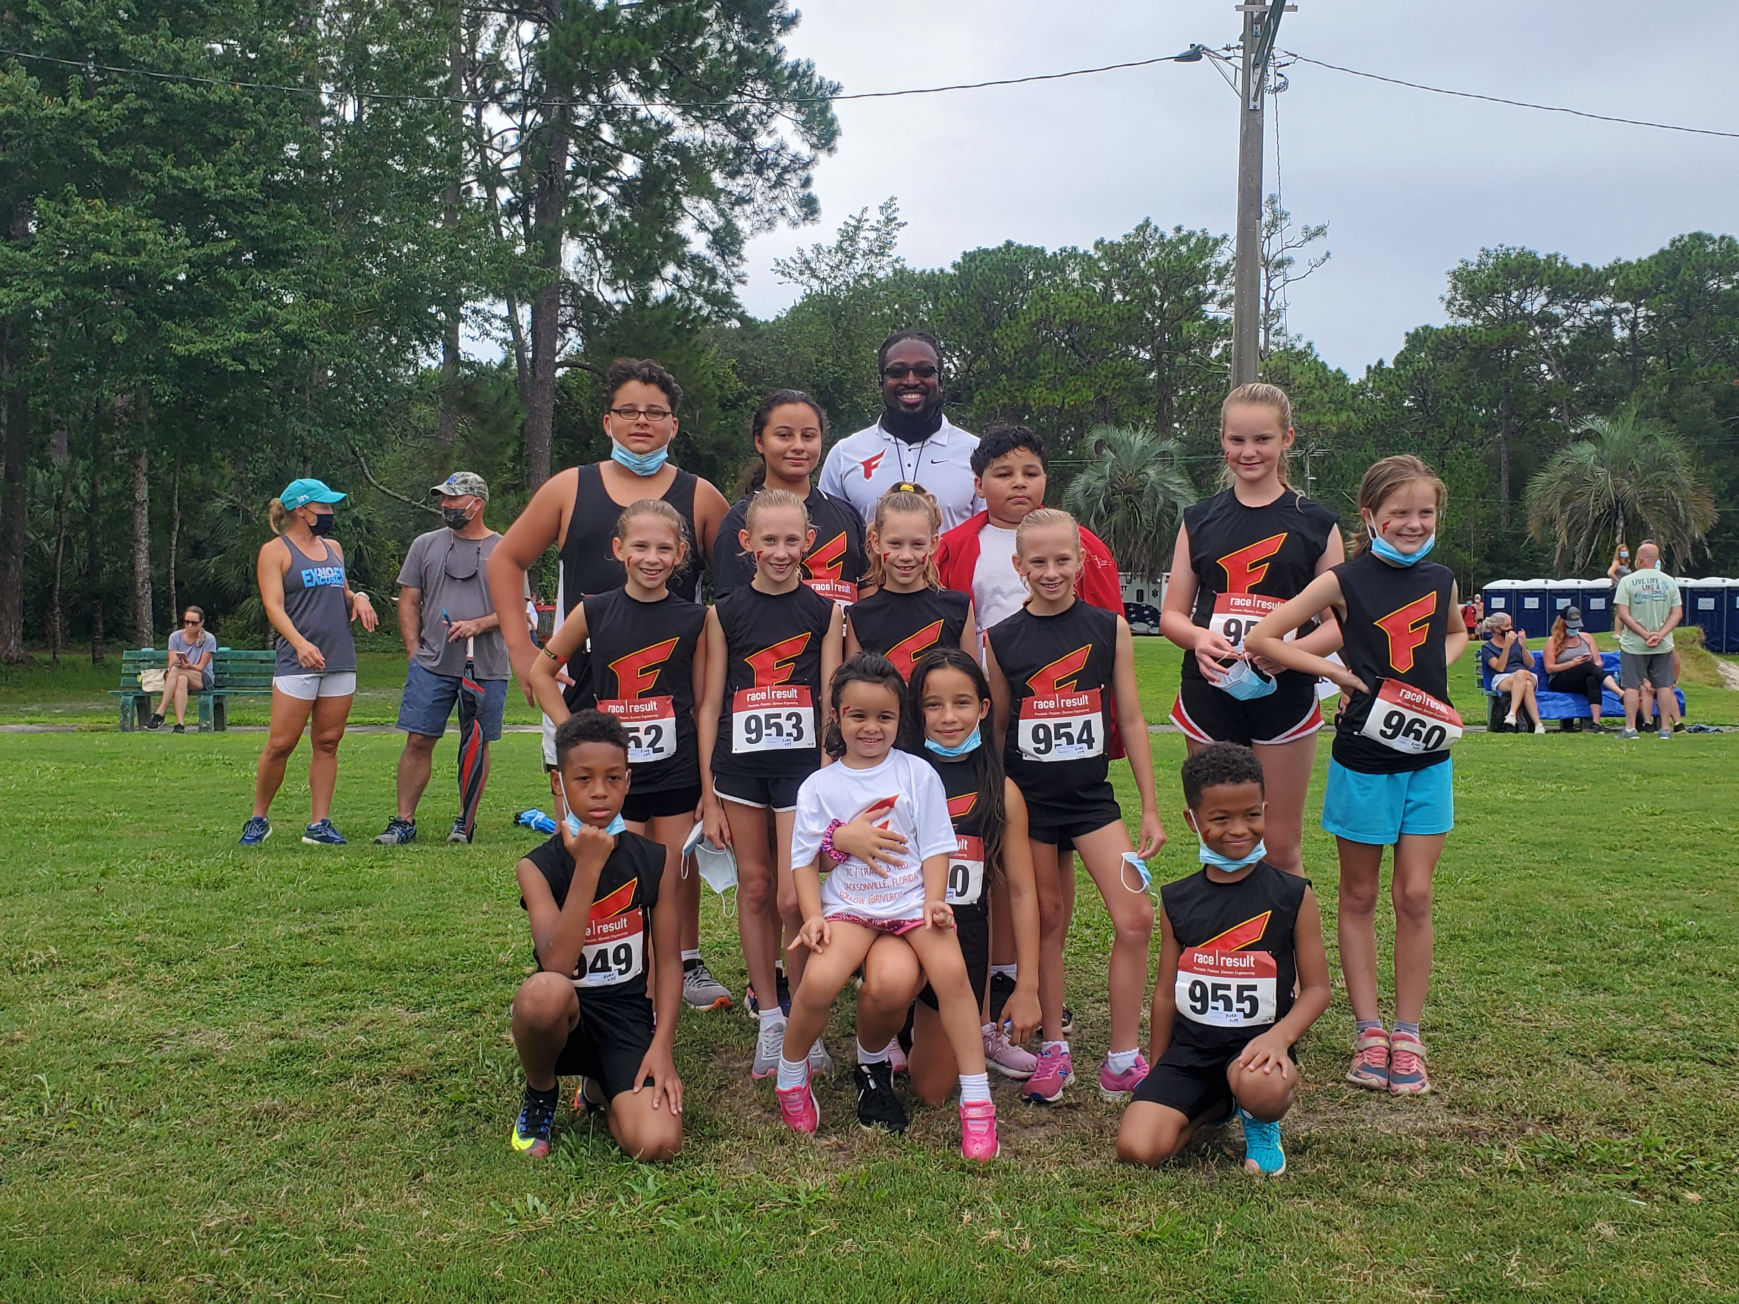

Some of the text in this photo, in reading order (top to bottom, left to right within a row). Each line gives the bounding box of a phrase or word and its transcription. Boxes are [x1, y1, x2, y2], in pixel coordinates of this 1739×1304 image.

[1230, 597, 1251, 606] race
[1373, 590, 1437, 674] F
[747, 688, 798, 702] race result
[1033, 695, 1089, 709] race result
[1400, 689, 1422, 703] race
[608, 701, 657, 714] race result
[744, 711, 804, 745] 953
[1379, 710, 1447, 752] 960
[627, 724, 665, 754] 52
[1031, 719, 1095, 755] 954
[892, 872, 920, 887] FLORIDA
[597, 917, 628, 933] result
[1193, 952, 1255, 968] race result
[1188, 979, 1259, 1019] 955
